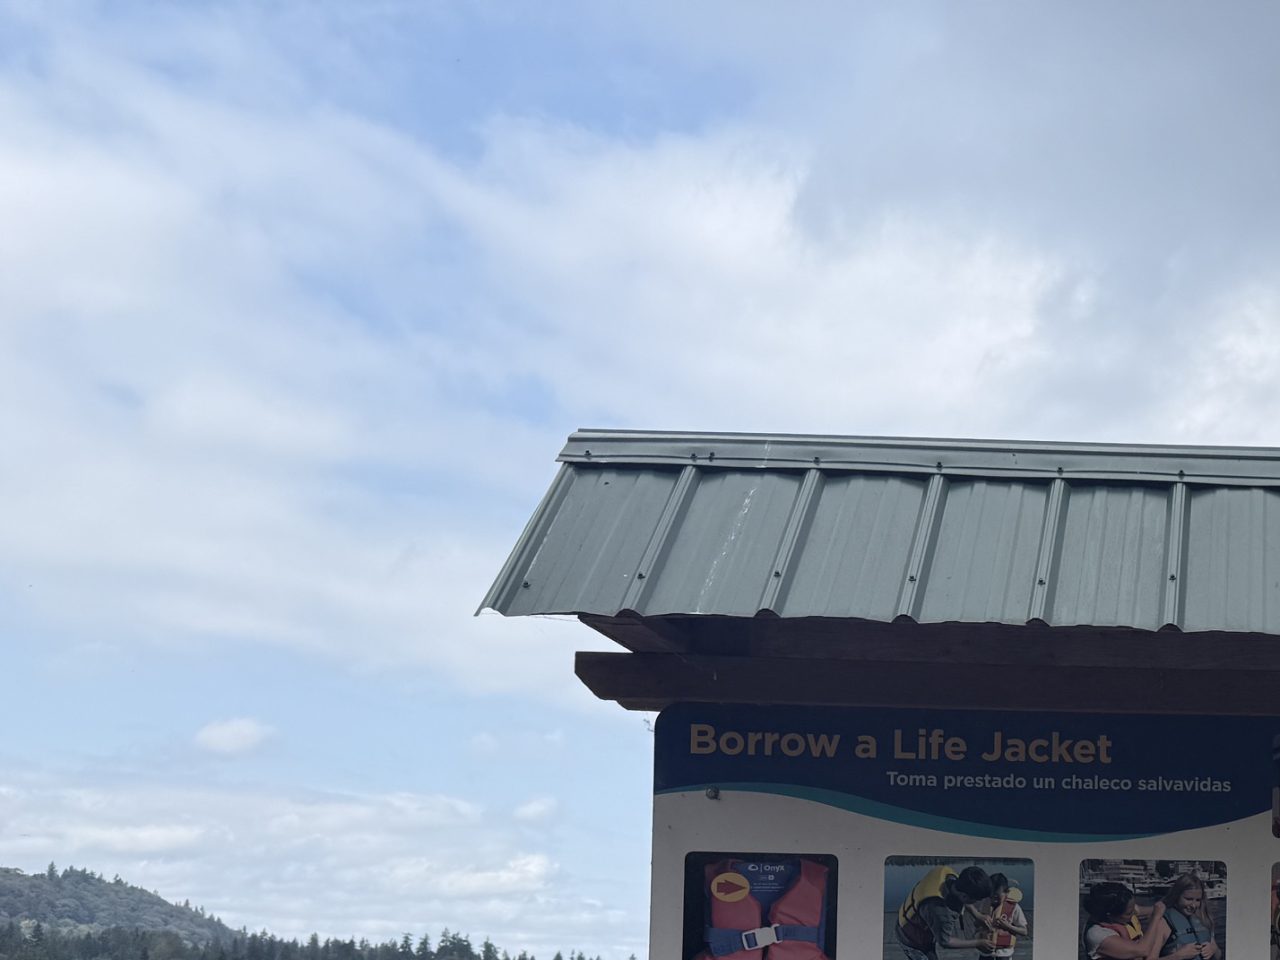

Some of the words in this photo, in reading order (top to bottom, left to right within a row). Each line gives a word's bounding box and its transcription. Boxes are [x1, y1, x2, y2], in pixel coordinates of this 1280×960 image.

[691, 725, 840, 756] Borrow
[855, 736, 877, 758] a
[894, 729, 968, 760] Life
[982, 732, 1112, 763] Jacket
[886, 772, 937, 786] Toma
[944, 774, 1026, 789] prestado
[1034, 778, 1055, 788] un
[1062, 775, 1132, 790] chaleco
[1138, 777, 1231, 791] salvavidas
